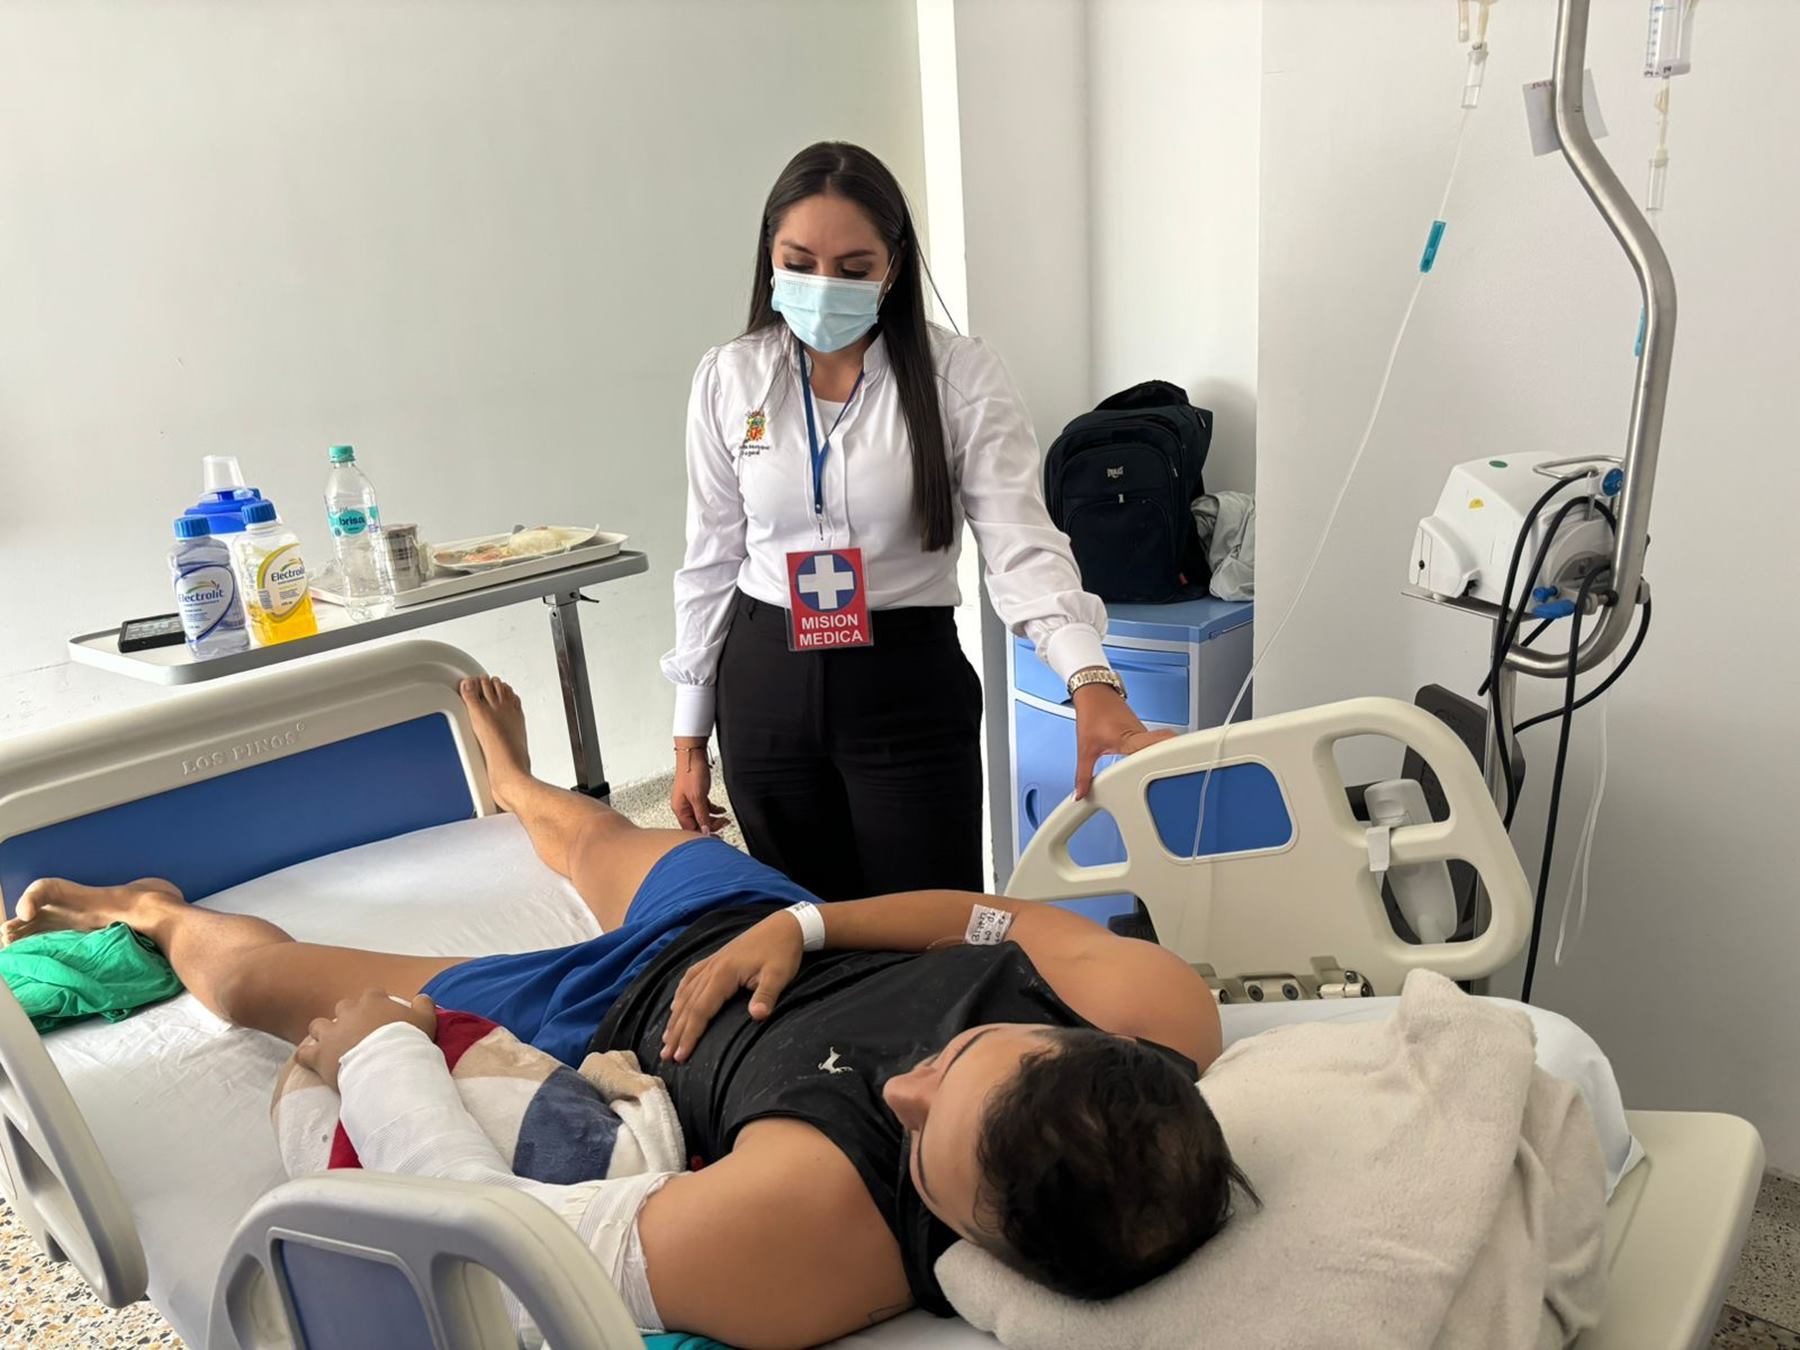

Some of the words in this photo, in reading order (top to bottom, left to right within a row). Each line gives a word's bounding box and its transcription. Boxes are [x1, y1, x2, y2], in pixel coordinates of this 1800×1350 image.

[339, 515, 366, 526] brisa
[802, 614, 858, 630] MISION
[799, 629, 863, 646] MEDICA
